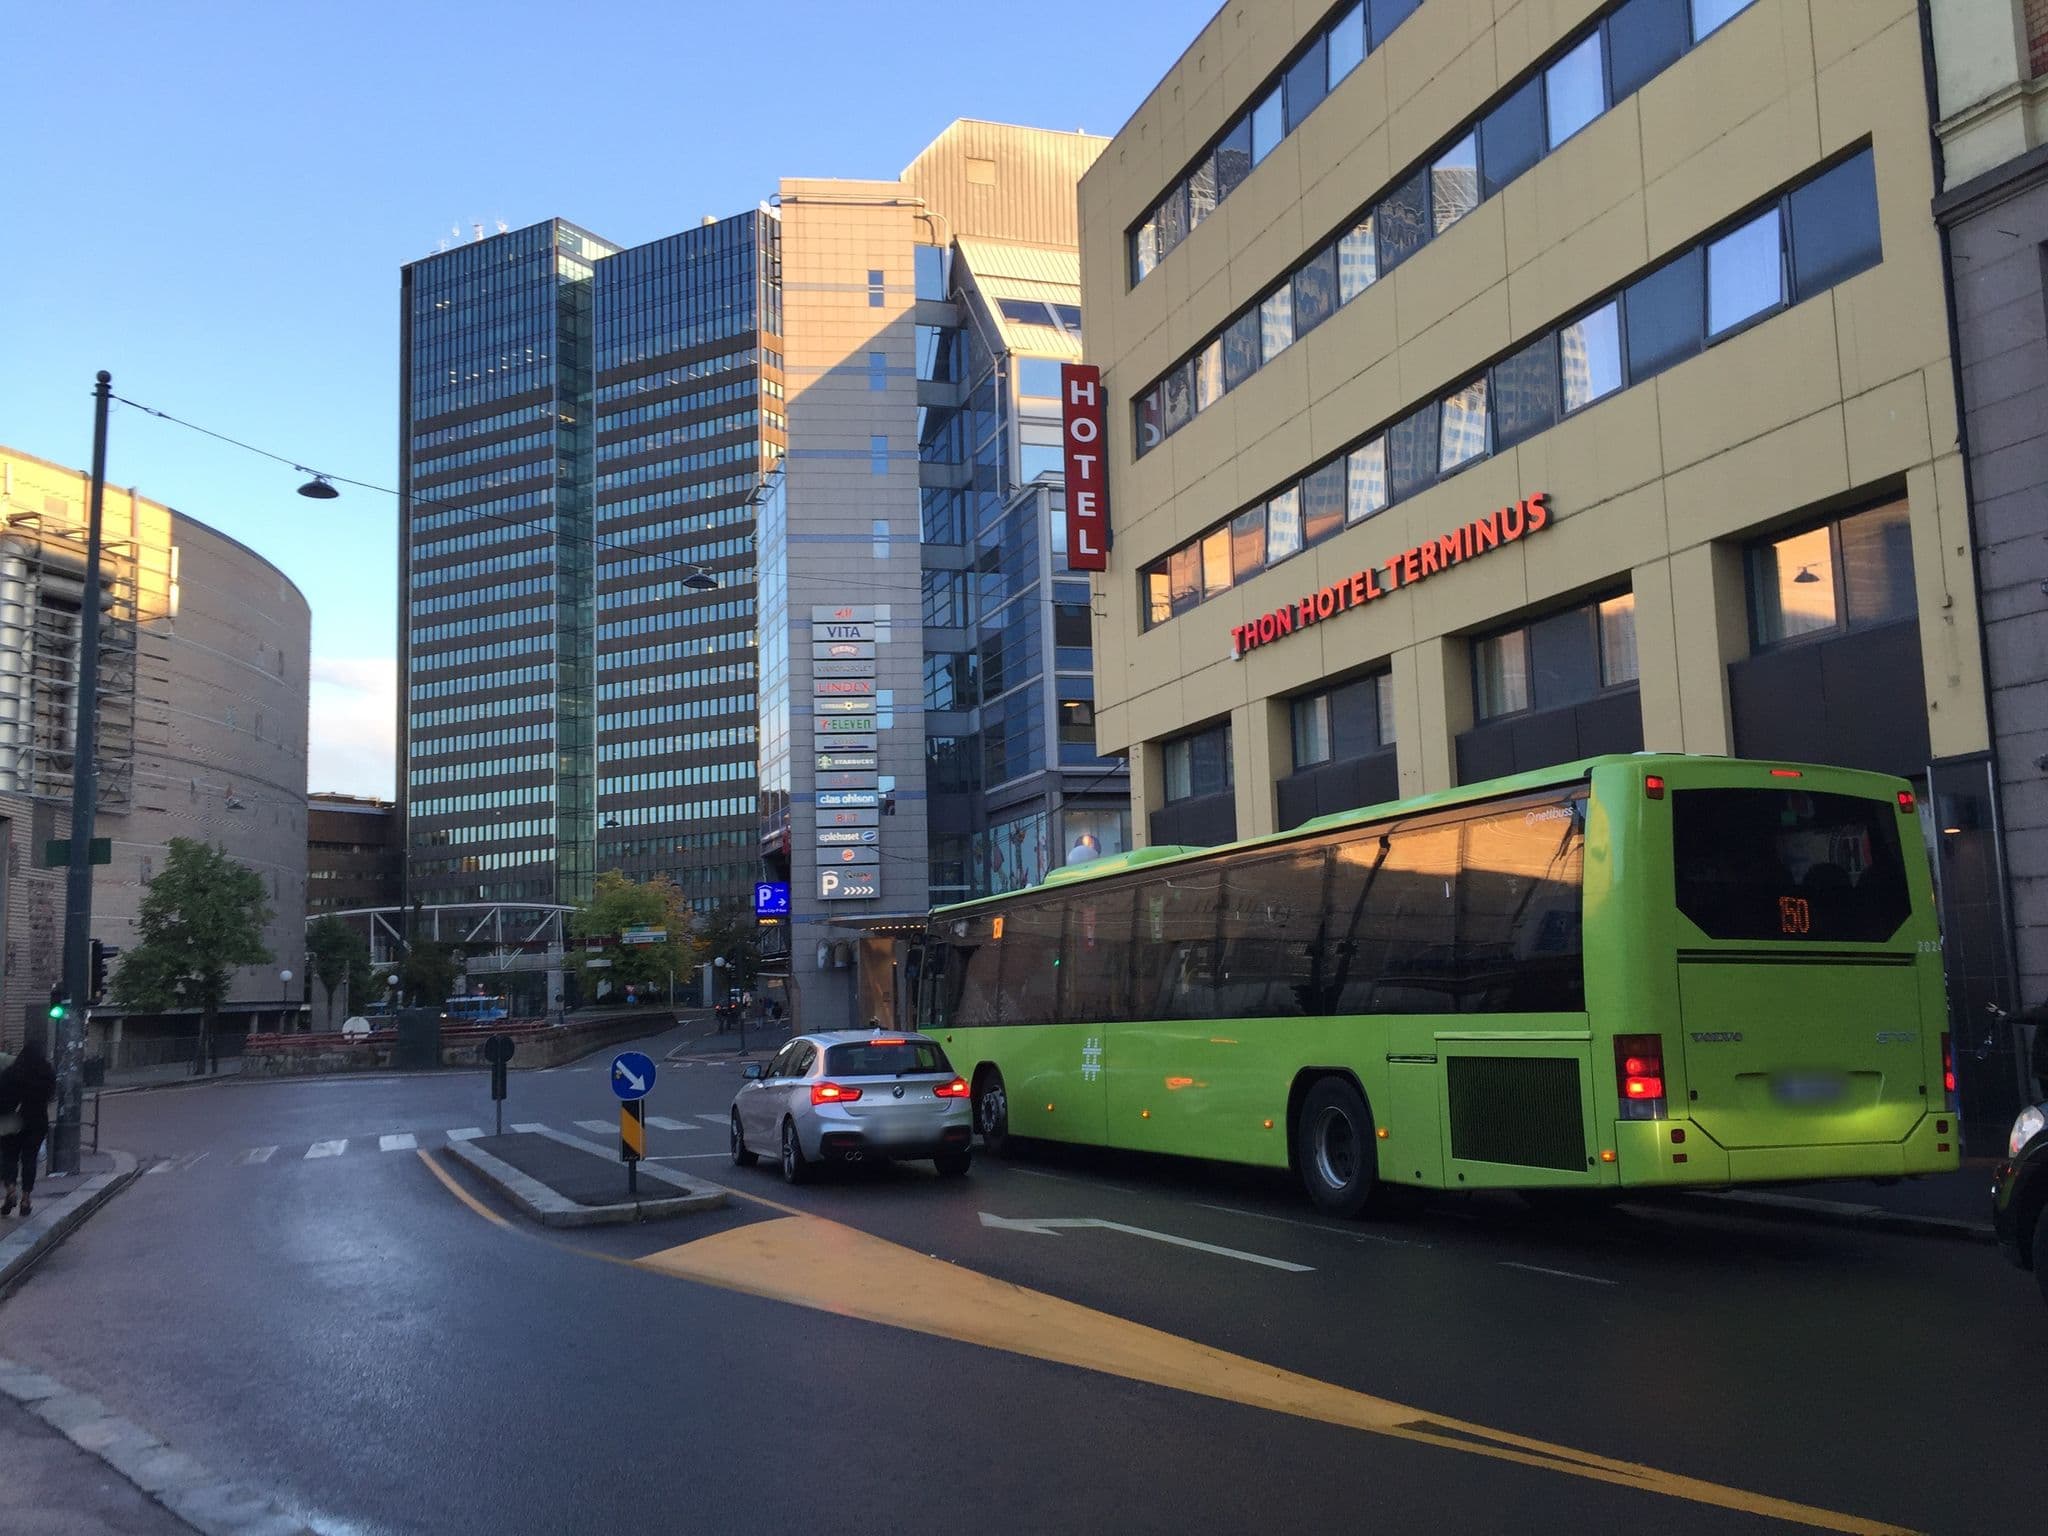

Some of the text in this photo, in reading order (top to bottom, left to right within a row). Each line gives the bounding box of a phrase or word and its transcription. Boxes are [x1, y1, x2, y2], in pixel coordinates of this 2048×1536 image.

[1070, 380, 1098, 554] HOTEL
[1231, 492, 1551, 654] THON HOTEL TERMINUS
[827, 626, 861, 638] VITA
[820, 793, 875, 804] clas ohlson
[822, 875, 839, 896] P
[759, 888, 772, 907] P
